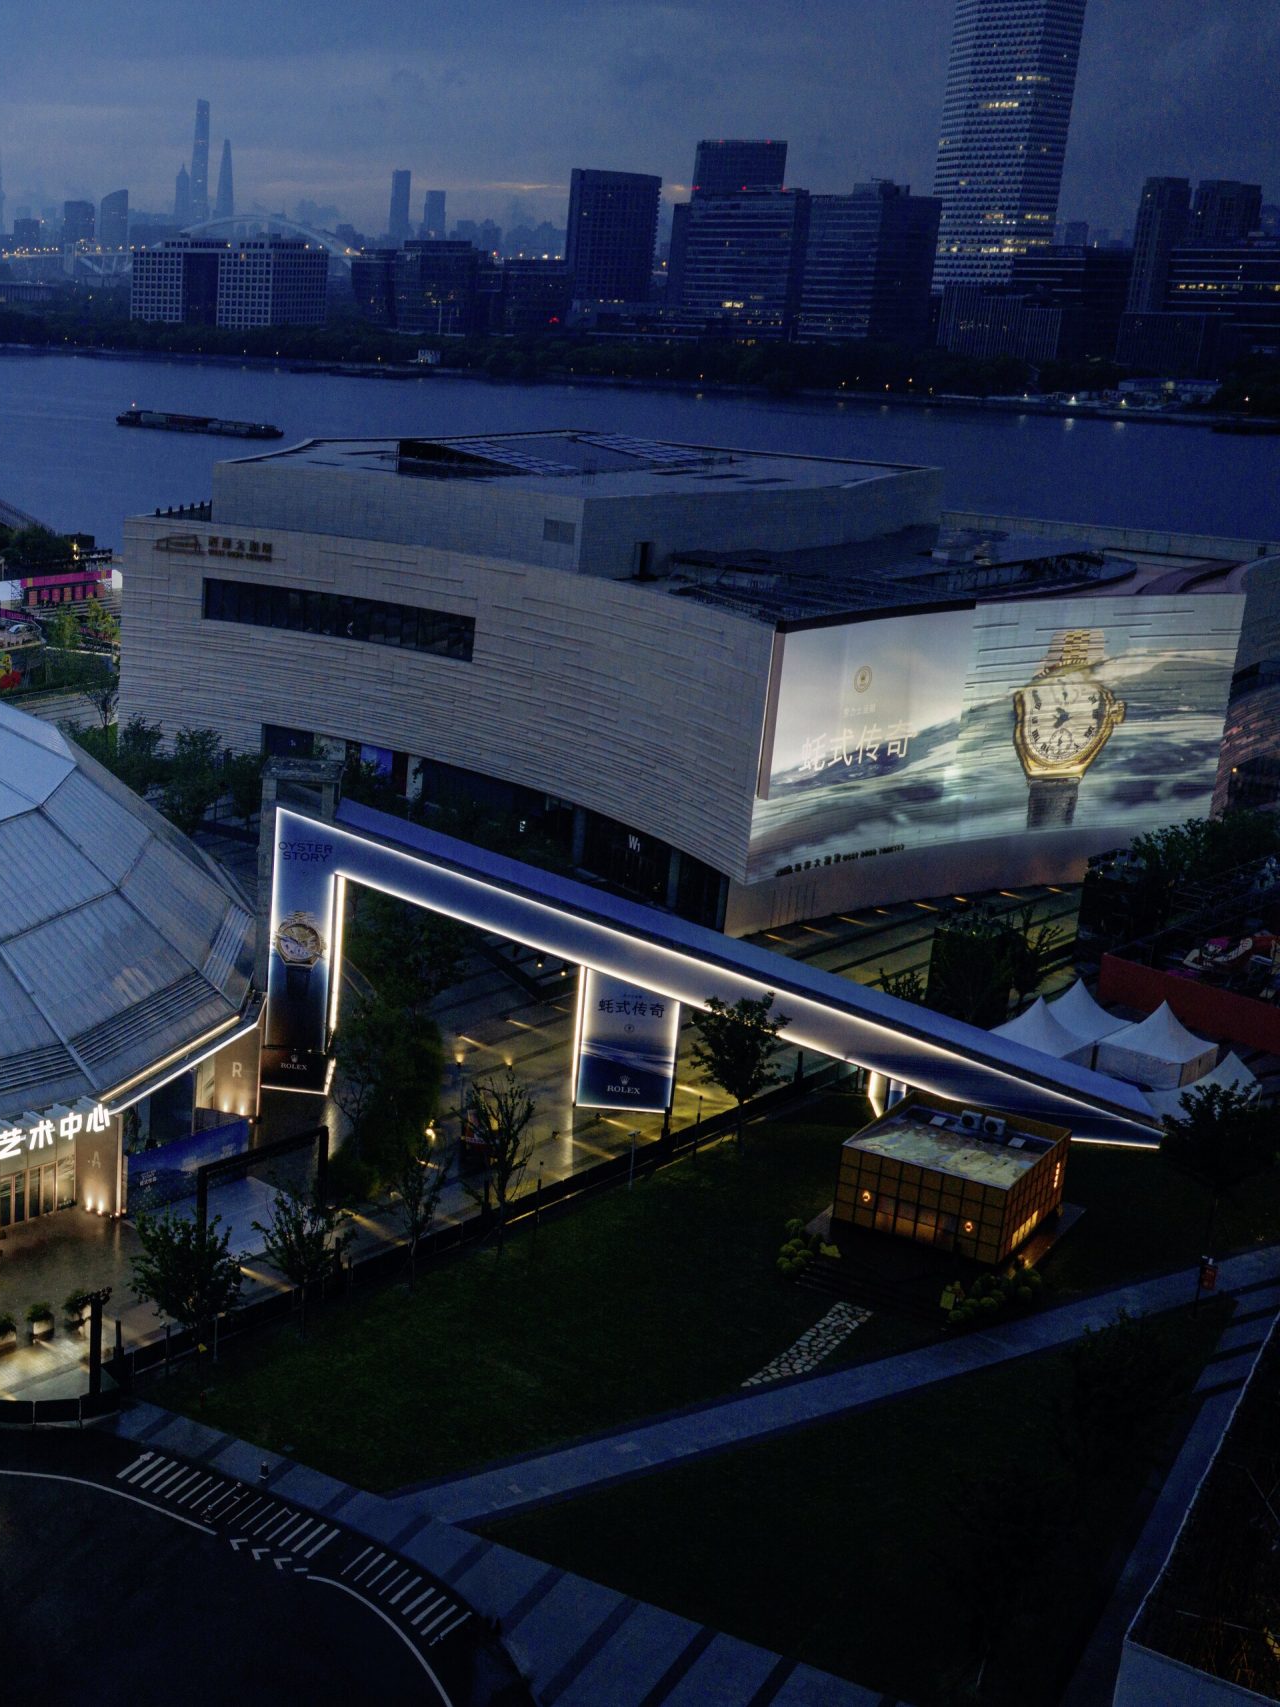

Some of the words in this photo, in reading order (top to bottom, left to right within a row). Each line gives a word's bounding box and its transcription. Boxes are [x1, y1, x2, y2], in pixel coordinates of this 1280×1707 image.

[799, 721, 917, 771] 蚝式传奇
[279, 841, 333, 853] OYSTER
[283, 851, 329, 862] STORY
[598, 999, 665, 1018] 蚝式传奇
[232, 1061, 242, 1078] R
[280, 1062, 308, 1071] ROLEX
[607, 1085, 641, 1095] ROLEX
